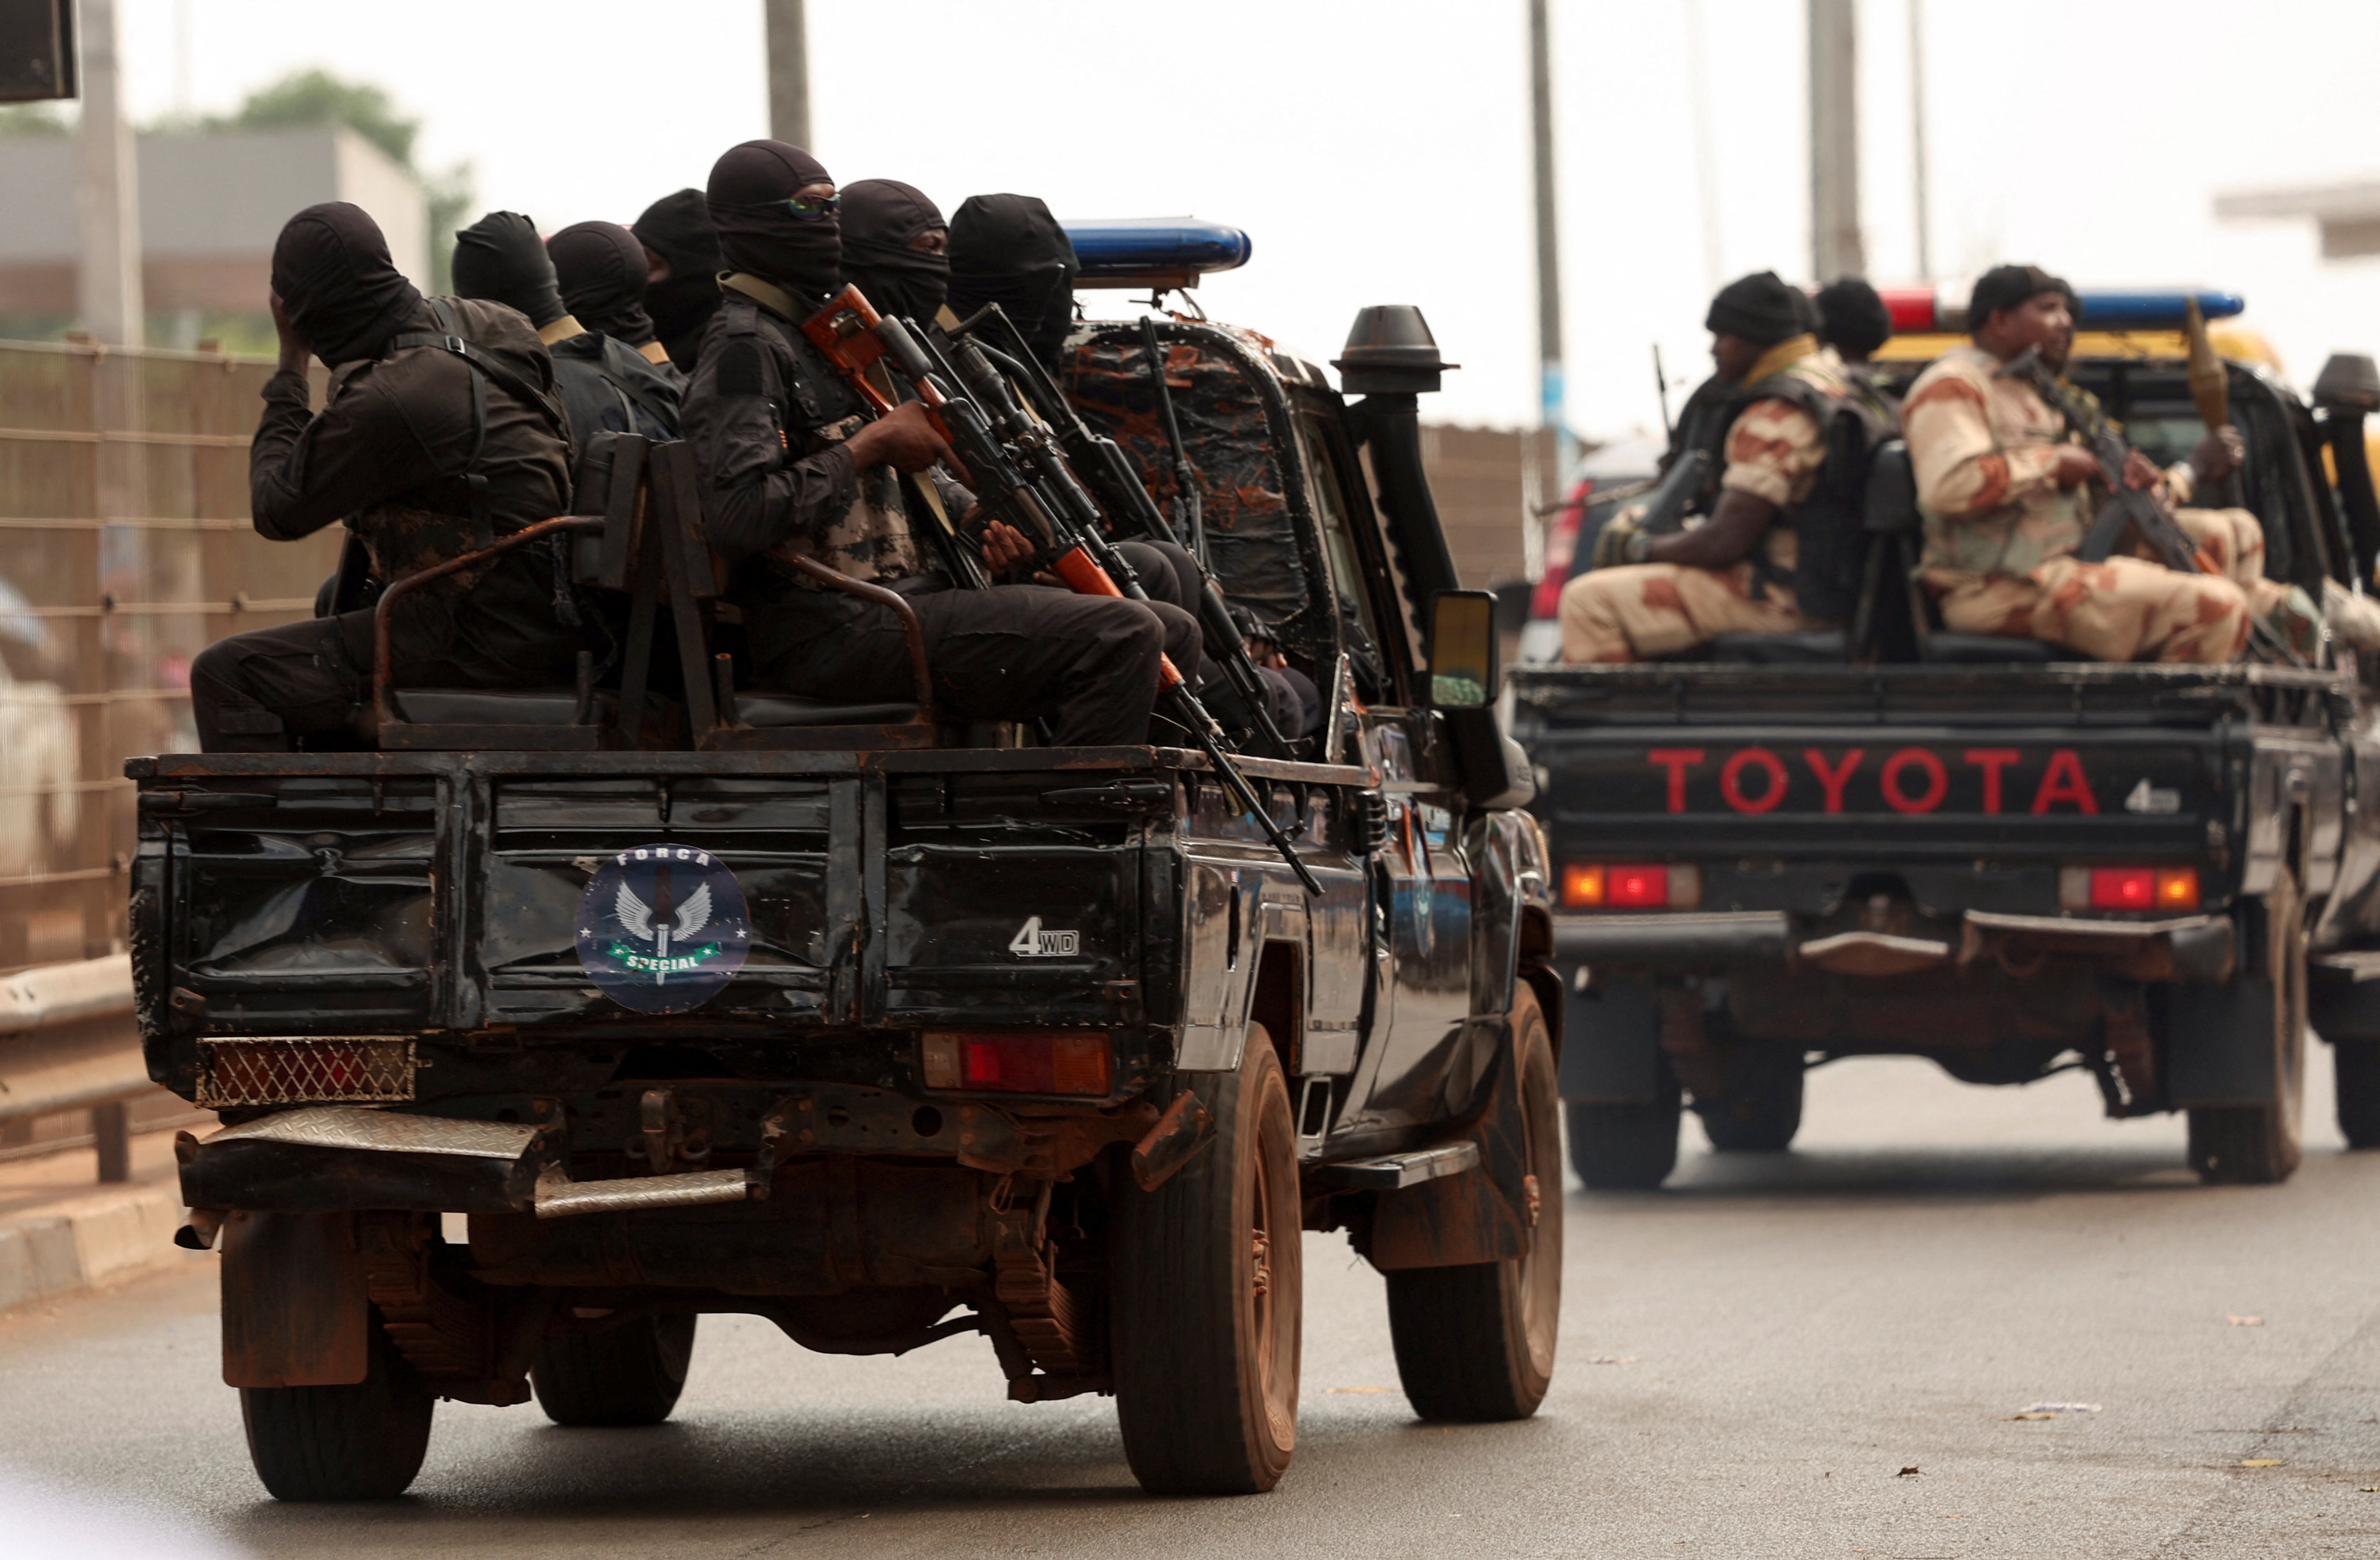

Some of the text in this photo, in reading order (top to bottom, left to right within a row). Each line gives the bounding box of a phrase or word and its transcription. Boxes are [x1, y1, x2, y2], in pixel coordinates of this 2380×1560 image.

[1647, 747, 2100, 816] TOYOTA
[1009, 916, 1079, 956] 4WD
[626, 955, 699, 970] SPECIAL
